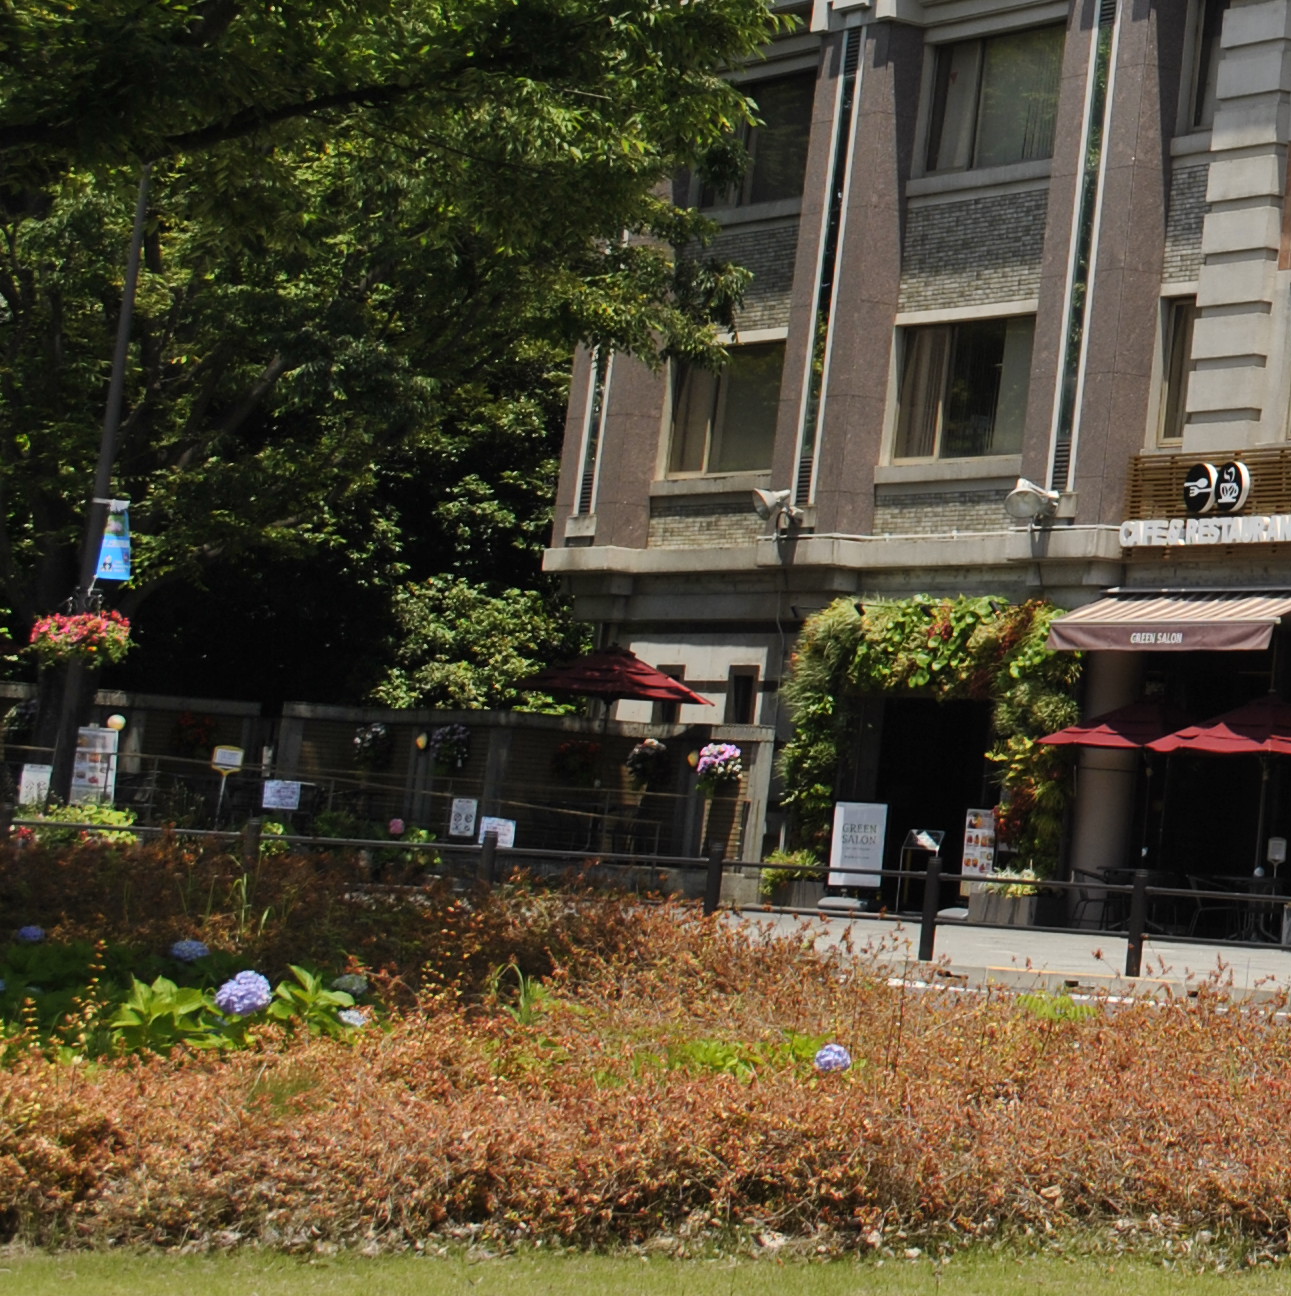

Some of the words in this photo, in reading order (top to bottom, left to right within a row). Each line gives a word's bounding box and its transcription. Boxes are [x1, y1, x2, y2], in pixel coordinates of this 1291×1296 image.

[1130, 632, 1155, 644] GREEN
[1157, 632, 1183, 644] SALON
[842, 823, 877, 834] GREEN
[842, 834, 877, 845] SALON
